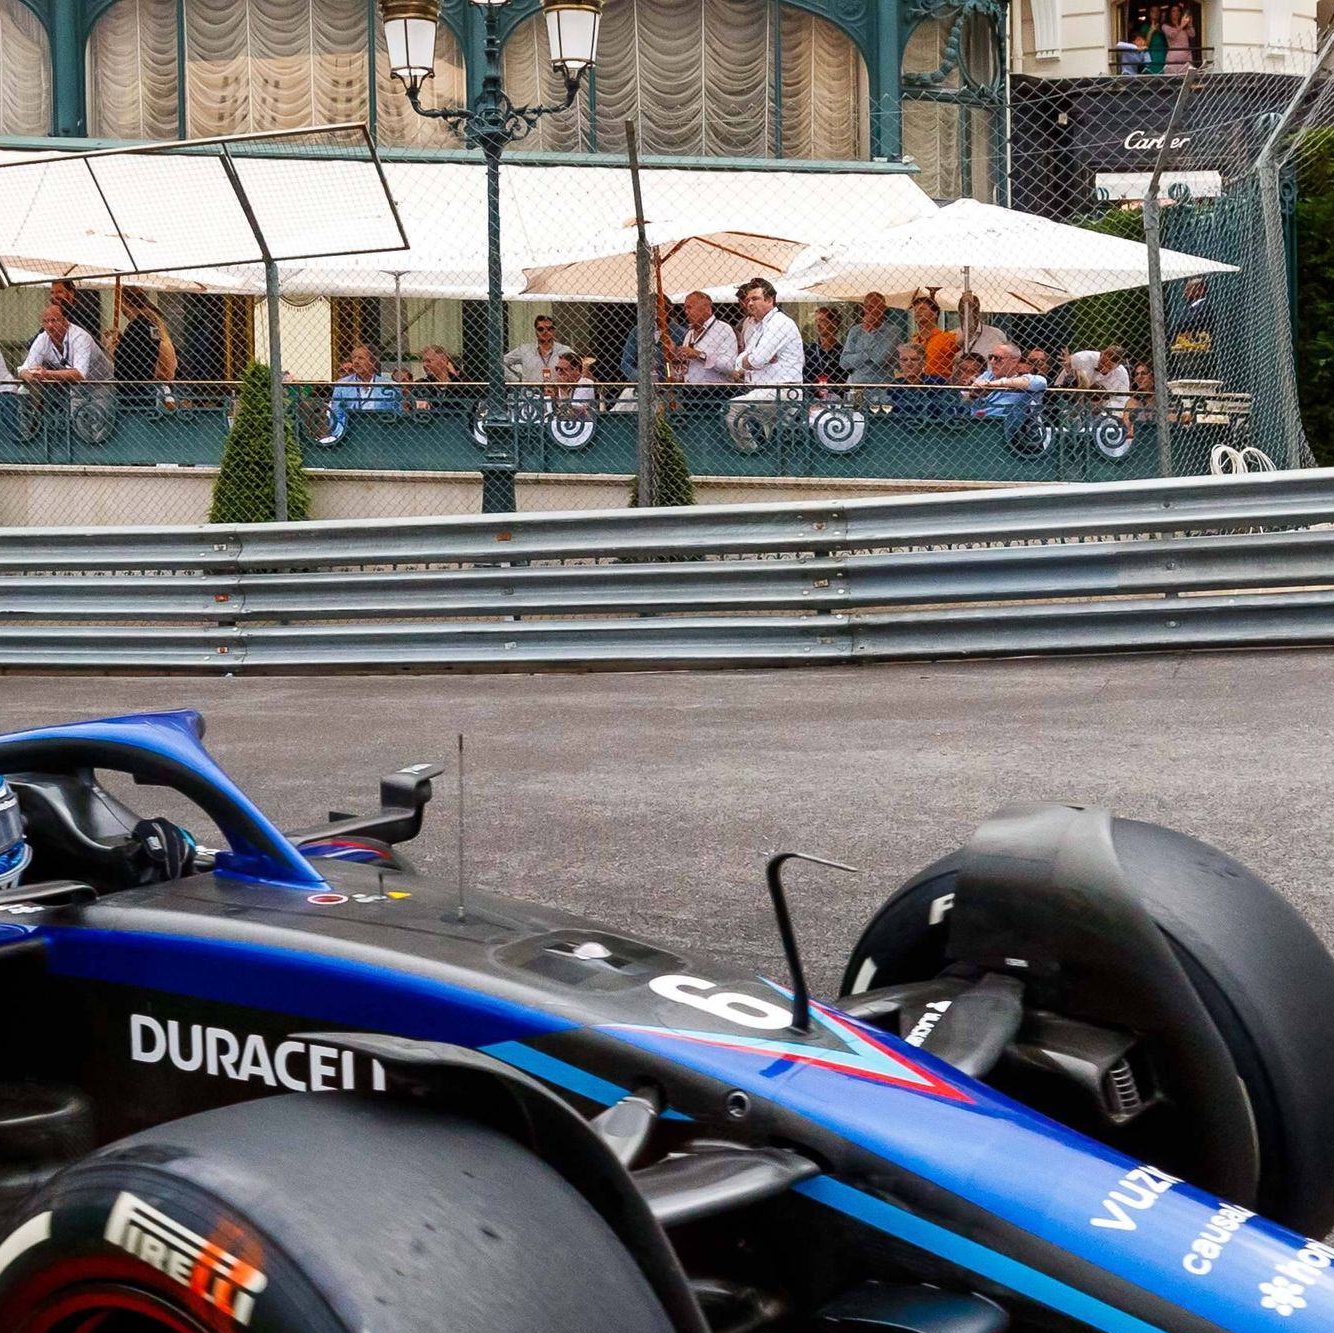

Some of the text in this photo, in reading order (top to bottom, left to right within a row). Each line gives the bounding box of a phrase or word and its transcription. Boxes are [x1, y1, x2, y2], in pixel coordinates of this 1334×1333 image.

[1124, 130, 1191, 150] Carter
[648, 974, 794, 1030] 6
[103, 1190, 268, 1327] PIRELLI
